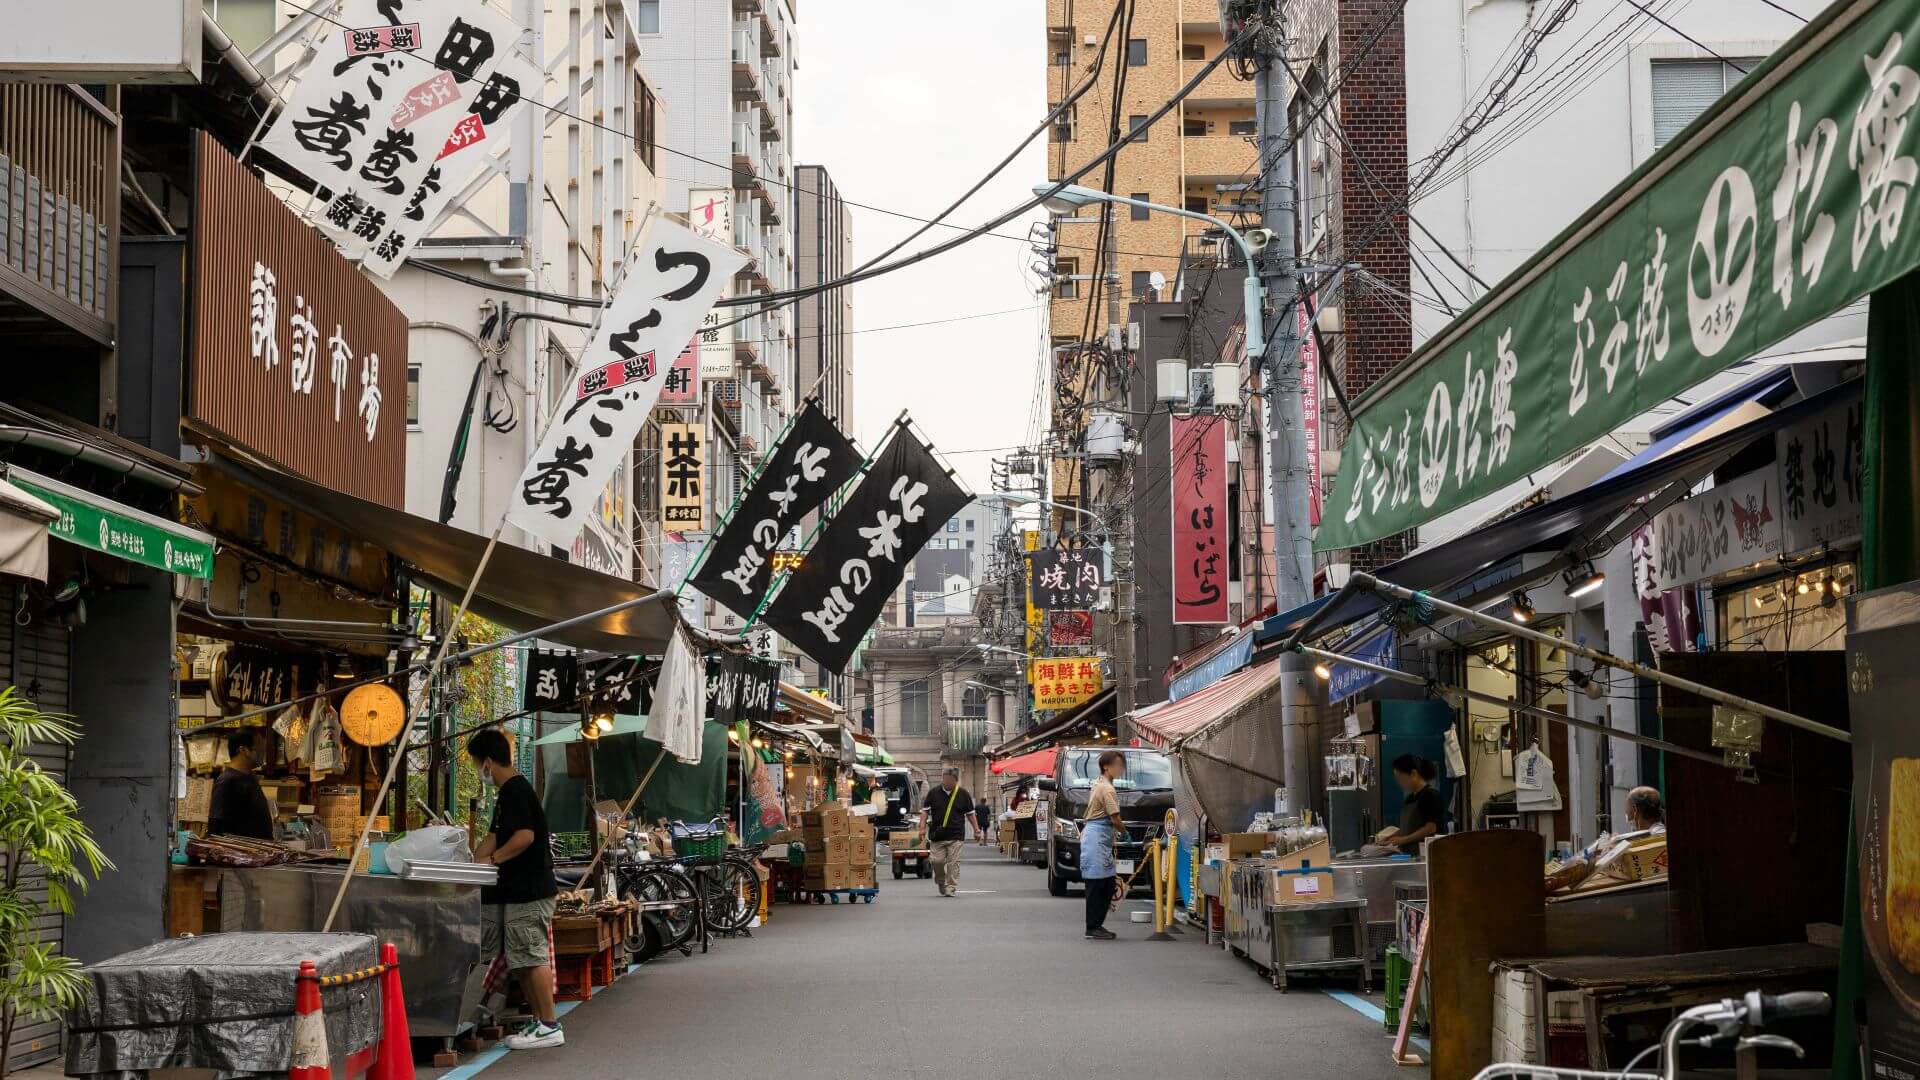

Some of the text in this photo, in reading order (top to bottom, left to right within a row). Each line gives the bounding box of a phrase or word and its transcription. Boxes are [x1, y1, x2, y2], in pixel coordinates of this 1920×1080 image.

[664, 432, 703, 499] 茶
[801, 475, 929, 643] 山本の豆
[1176, 504, 1221, 607] はいばら
[1039, 561, 1100, 591] 焼肉
[1049, 592, 1096, 604] まるきた
[1038, 661, 1095, 681] 海鮮丼
[1039, 683, 1096, 696] まるきた
[1041, 696, 1077, 705] MARUKITA
